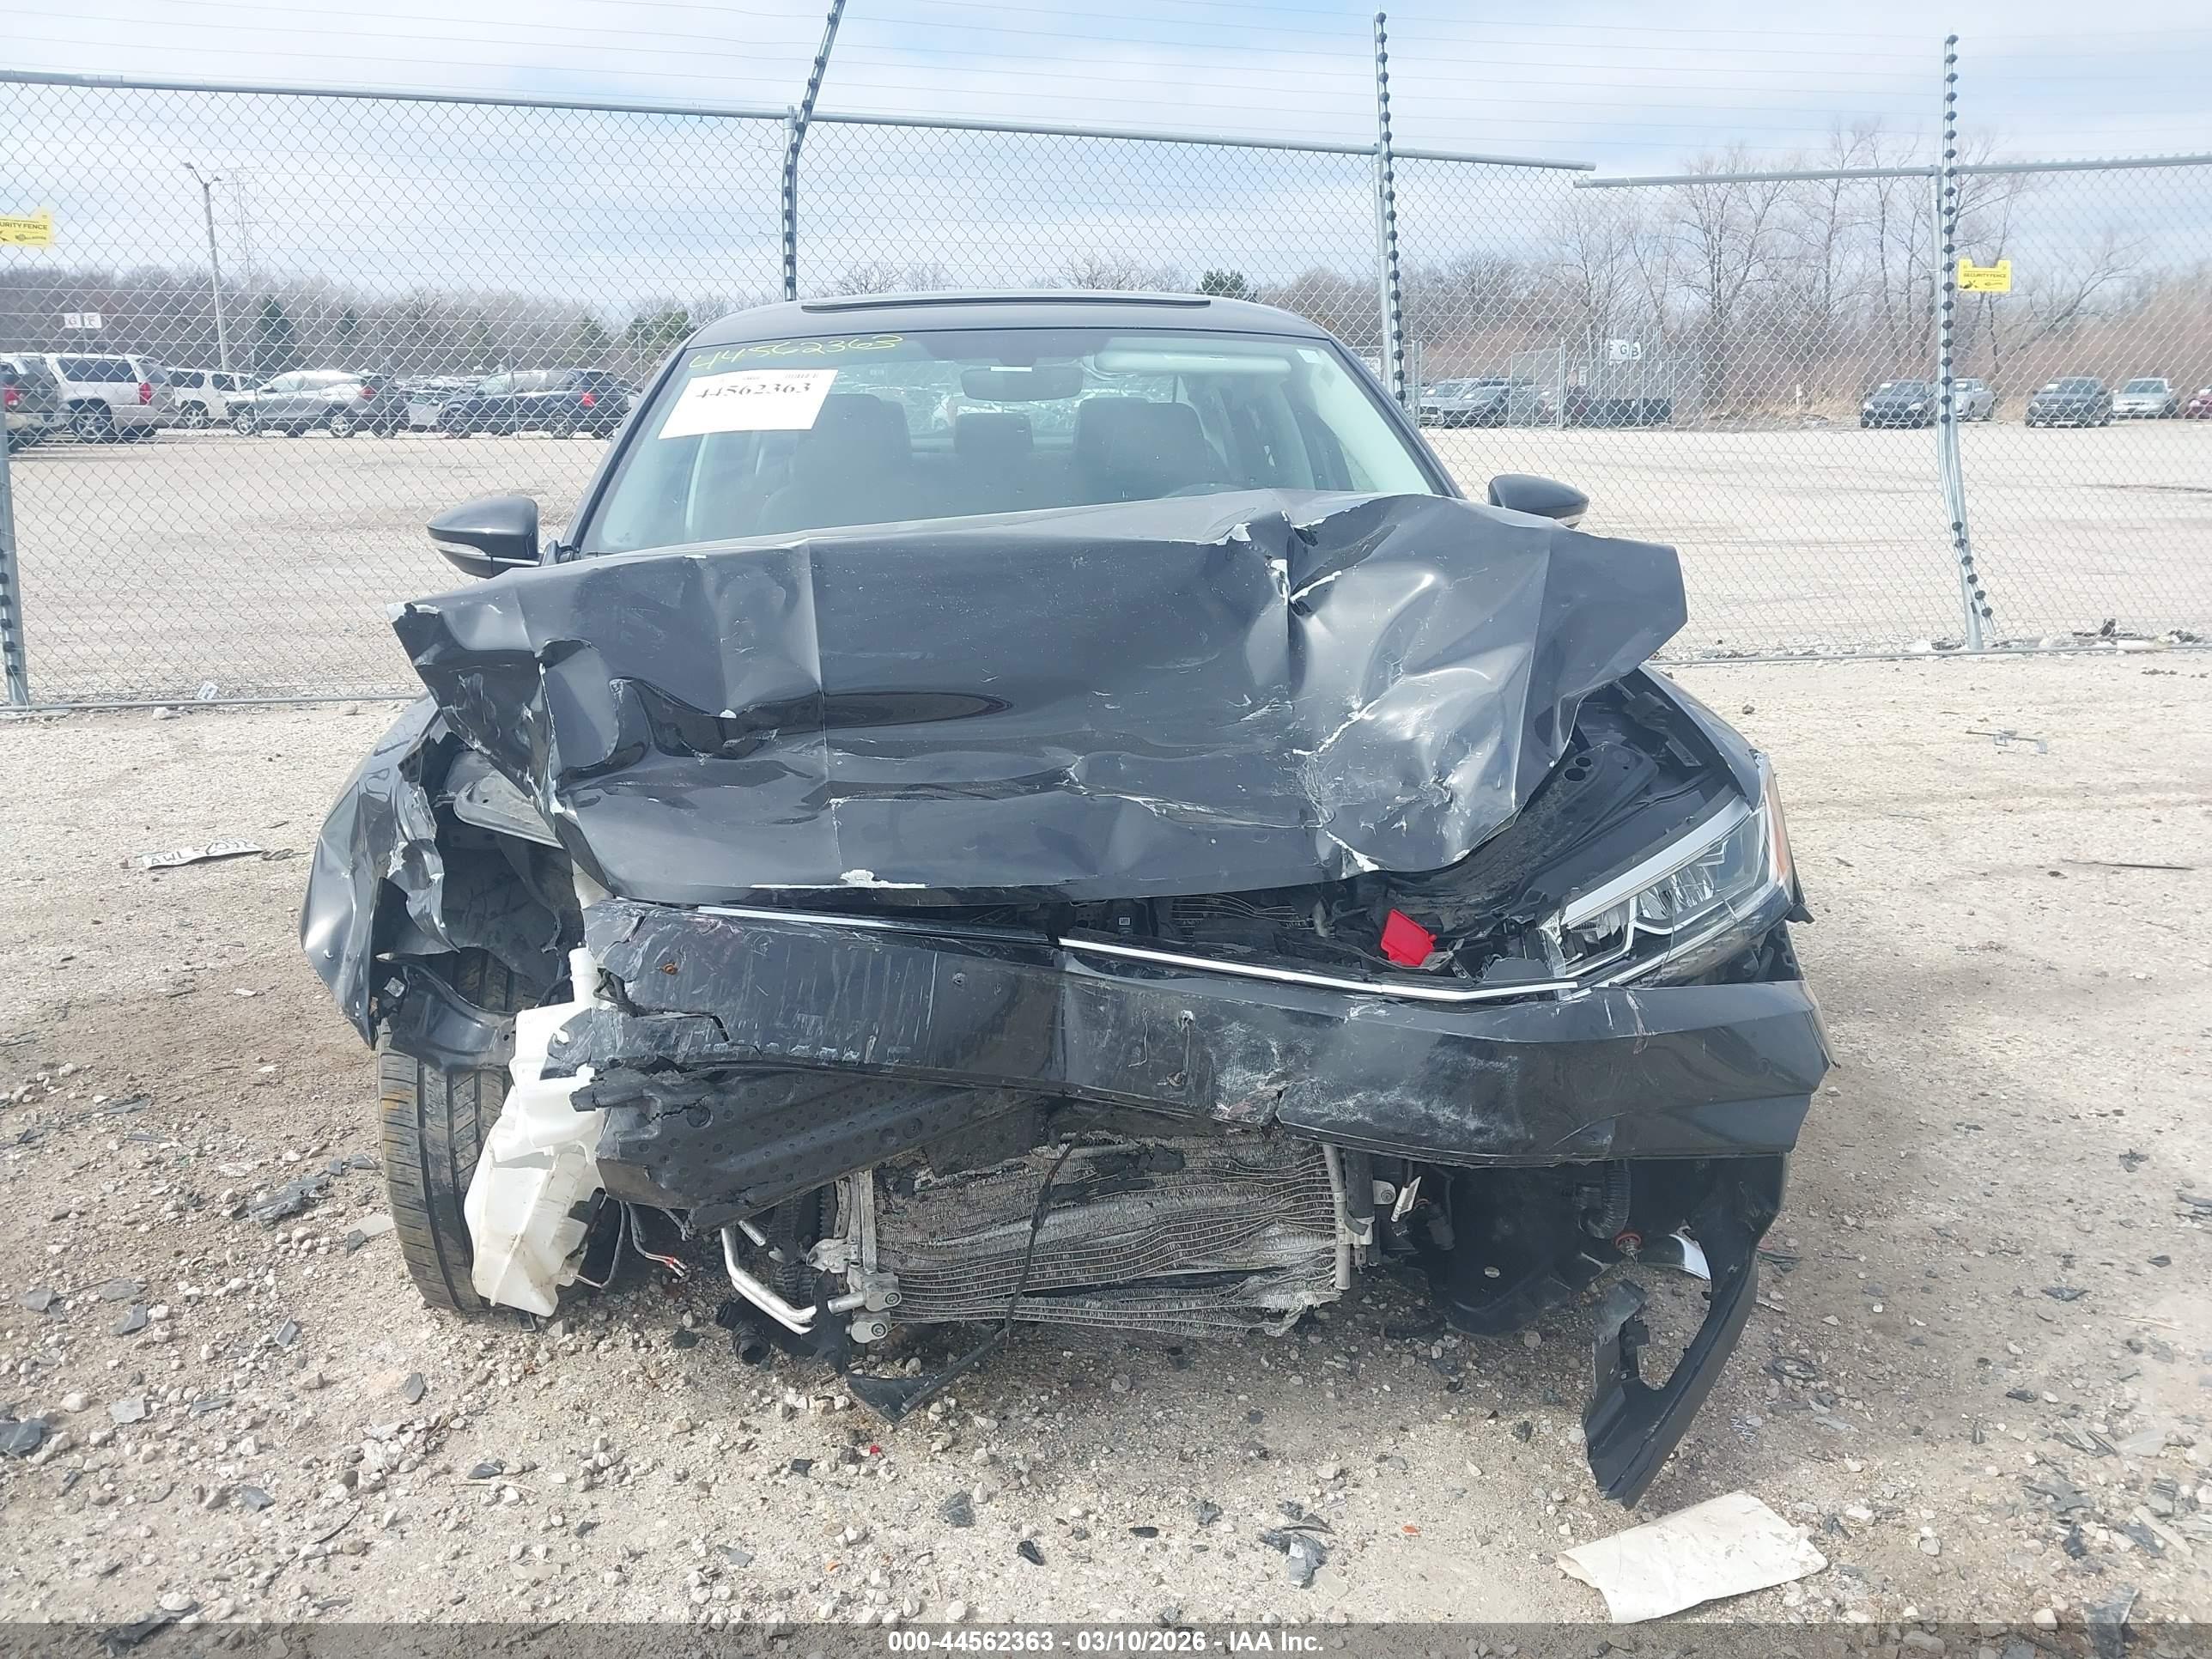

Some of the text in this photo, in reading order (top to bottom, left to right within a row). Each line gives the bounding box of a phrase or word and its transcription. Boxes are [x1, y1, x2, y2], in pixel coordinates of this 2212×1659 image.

[688, 334, 904, 369] 44562363
[1620, 344, 1627, 355] G
[695, 382, 811, 398] 44562363
